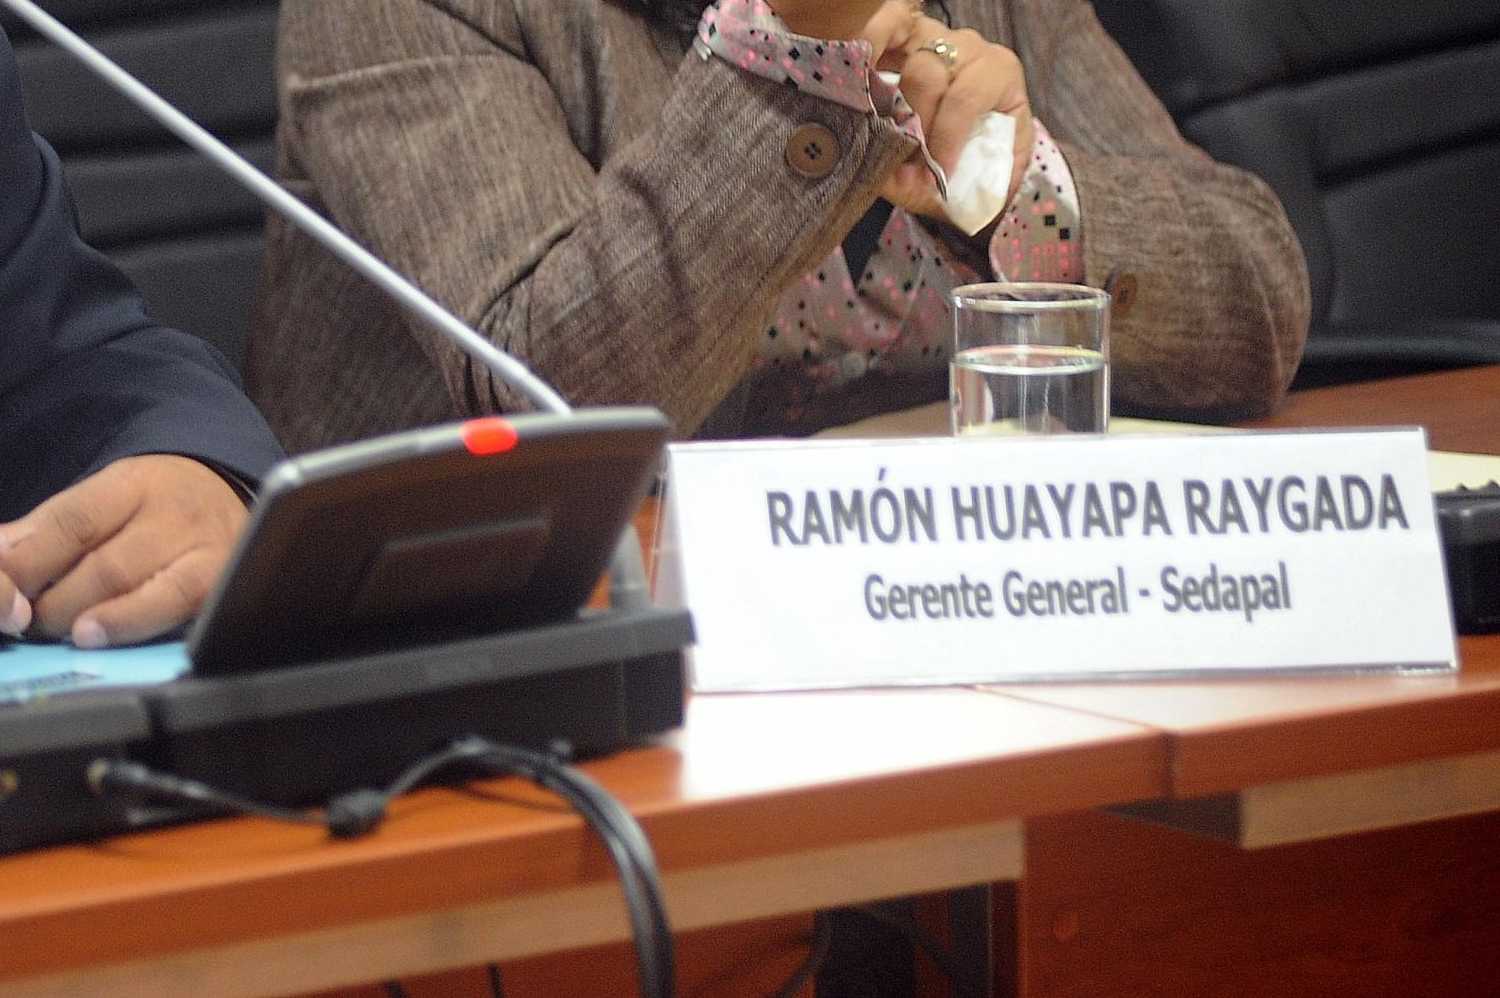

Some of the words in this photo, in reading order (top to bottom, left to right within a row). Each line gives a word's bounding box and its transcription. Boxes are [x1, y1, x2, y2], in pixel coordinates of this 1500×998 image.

[766, 466, 938, 546] RAMÓN
[950, 480, 1174, 542] HUAYAPA
[1182, 473, 1411, 537] RAYGADA
[863, 573, 995, 621] Gerente
[1001, 565, 1129, 618] General
[1137, 587, 1151, 598] -
[1159, 560, 1292, 624] Sedapal
